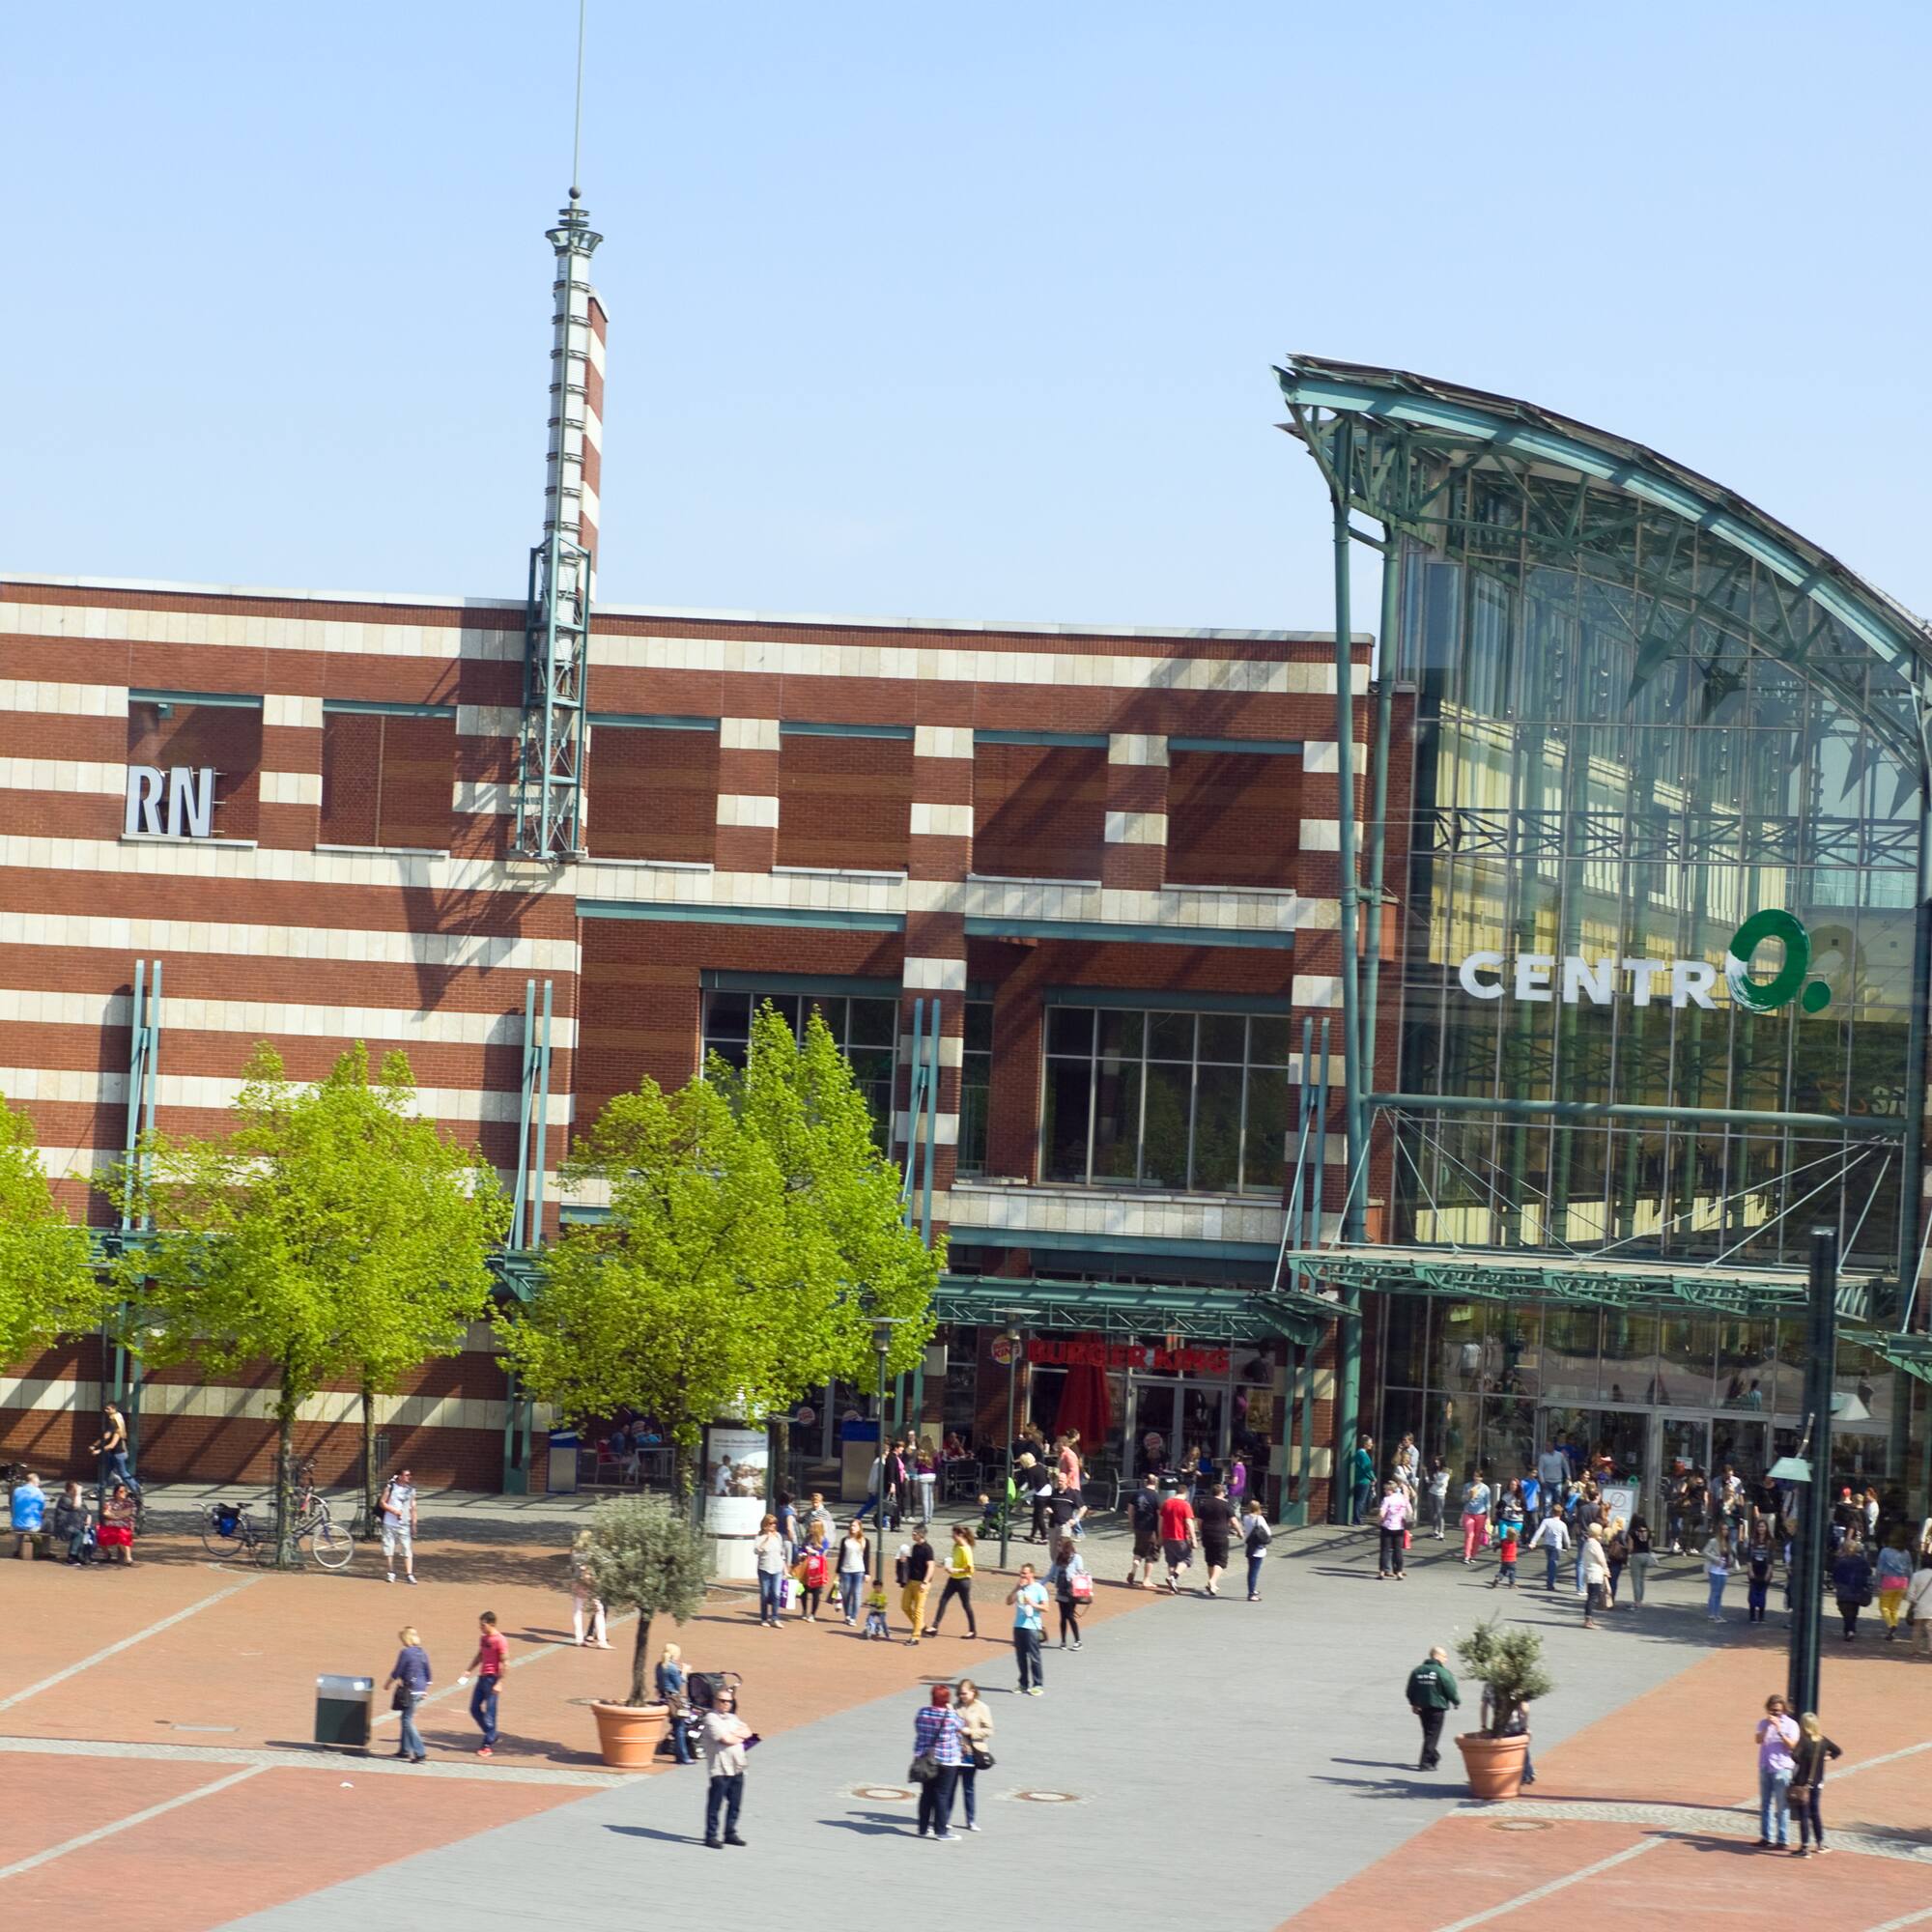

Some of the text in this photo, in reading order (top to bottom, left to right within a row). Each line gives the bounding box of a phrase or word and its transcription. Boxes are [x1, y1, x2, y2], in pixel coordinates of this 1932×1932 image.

[126, 765, 214, 838] RN
[1027, 1340, 1231, 1372] BURGER KING
